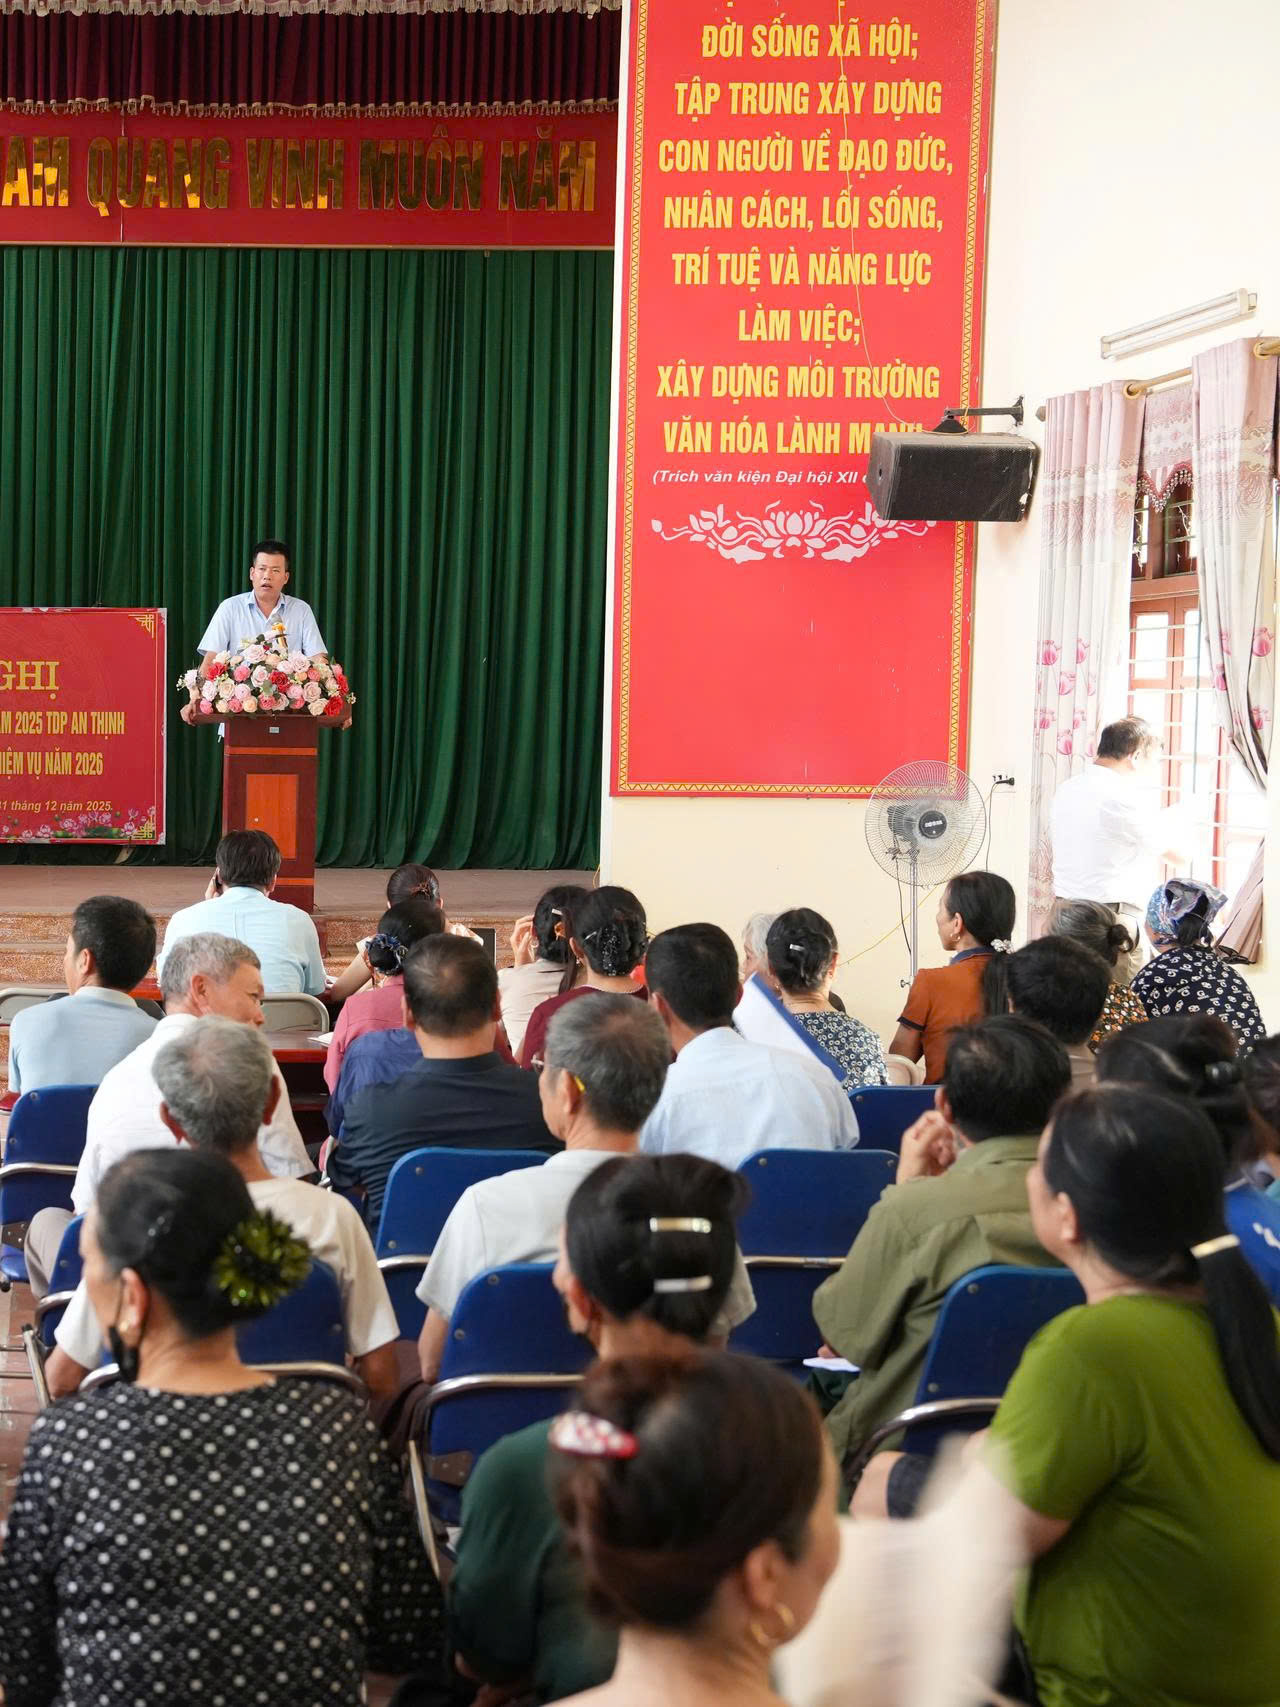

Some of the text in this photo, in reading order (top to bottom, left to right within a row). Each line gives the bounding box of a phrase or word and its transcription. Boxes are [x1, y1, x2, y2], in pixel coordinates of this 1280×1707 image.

[702, 12, 918, 64] ĐỜI SỐNG XÃ HỘI;
[675, 75, 942, 122] TẬP TRUNG XÂY DỰNG
[87, 136, 229, 216] QUANG
[246, 138, 343, 209] VINH
[359, 124, 484, 211] MUÔN
[498, 125, 597, 212] NĂM
[658, 128, 953, 179] CON NGƯỜI VỀ ĐẠO ĐỨC,
[664, 184, 943, 233] NHÂN CÁCH, LỐI SỐNG,
[672, 246, 932, 293] TRÍ TUỆ VÀ NĂNG LỰC
[738, 303, 861, 348] LÀM VIỆC;
[657, 359, 940, 405] XÂY DỰNG MÔI TRƯỜNG
[664, 416, 712, 453] VĂN
[720, 416, 769, 453] HÓA
[777, 416, 840, 453] LÀNH
[652, 470, 698, 485] (Trích
[704, 470, 732, 482] văn
[737, 470, 770, 485] kiện
[775, 471, 802, 485] Đại
[806, 471, 832, 486] hội
[836, 471, 858, 483] XII
[15, 711, 43, 734] 2025
[46, 711, 68, 734] TDP
[71, 711, 88, 735] AN
[91, 711, 125, 740] THỊNH
[27, 752, 42, 780] VỤ
[45, 747, 72, 775] NĂM
[75, 752, 103, 775] 2026
[11, 800, 41, 813] tháng
[45, 800, 57, 811] 12
[60, 800, 83, 811] năm
